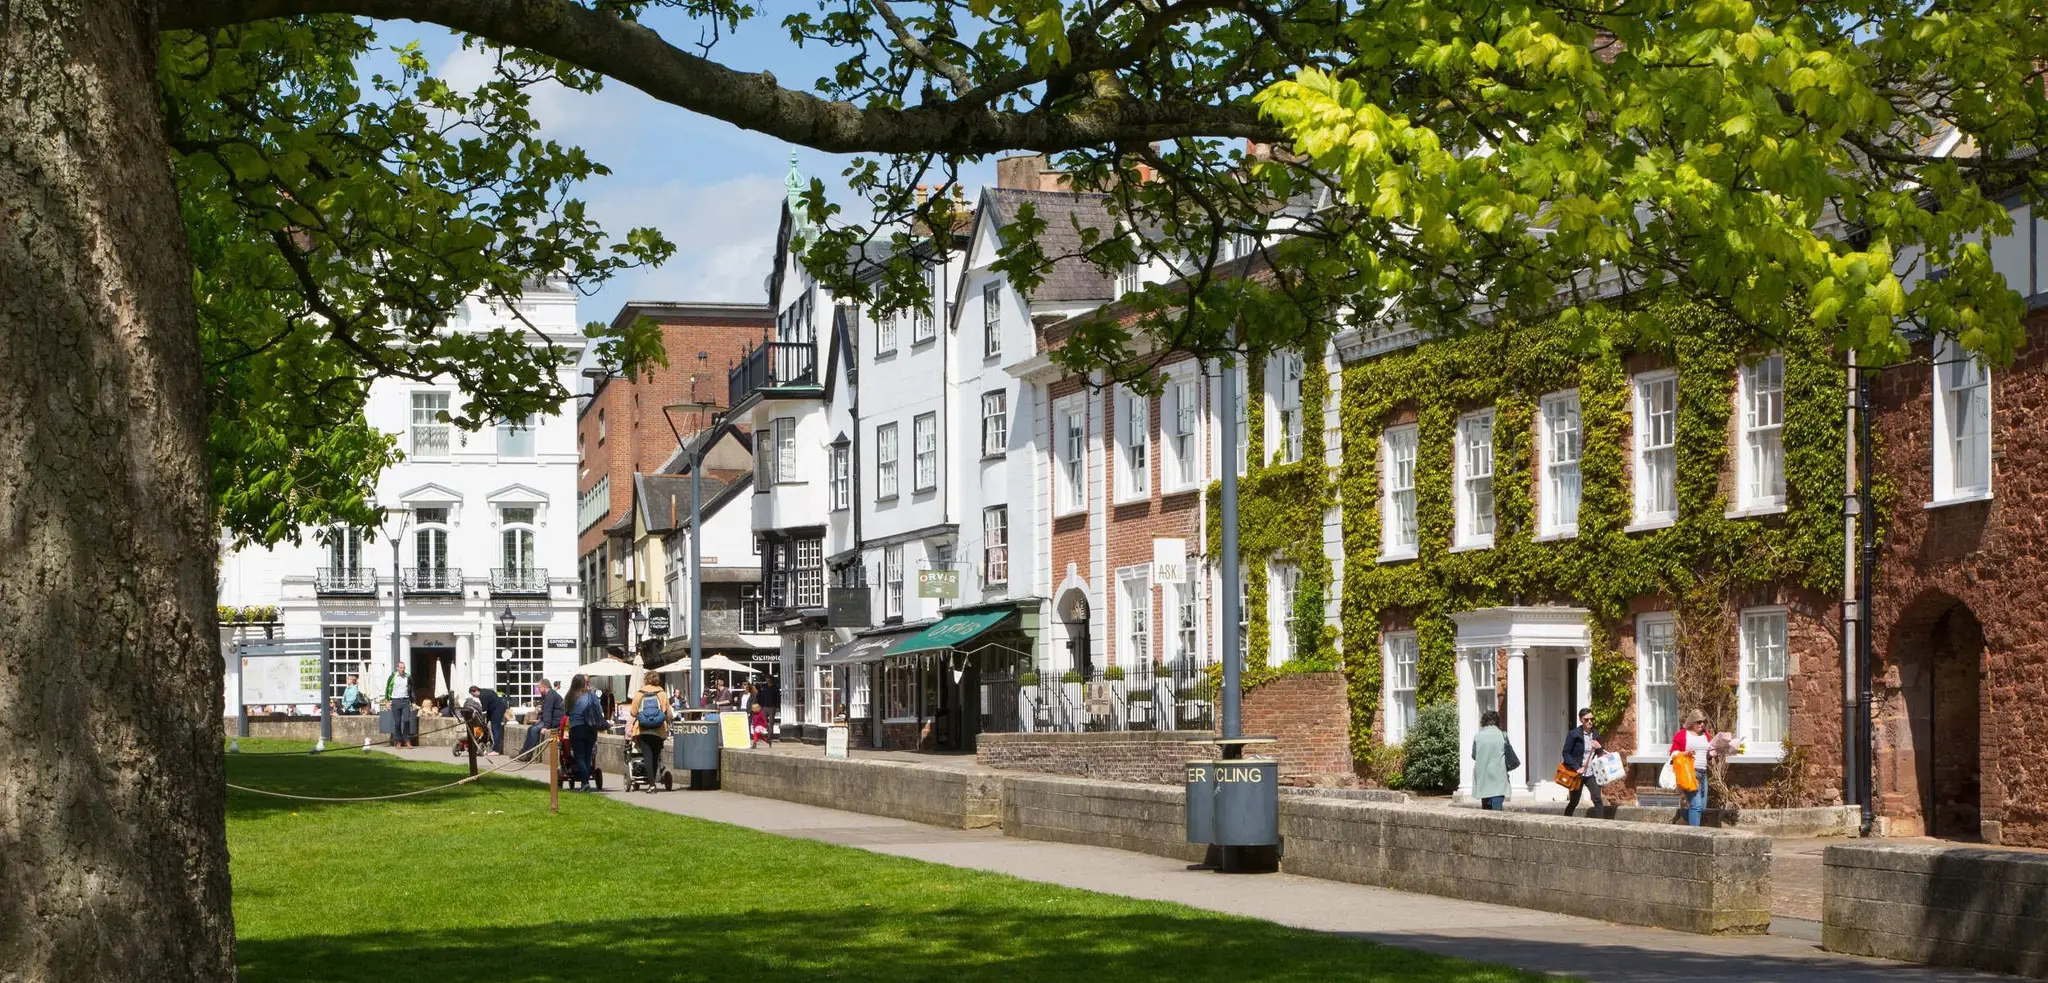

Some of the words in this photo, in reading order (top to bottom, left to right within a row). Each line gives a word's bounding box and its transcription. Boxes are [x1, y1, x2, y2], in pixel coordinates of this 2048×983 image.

[919, 572, 957, 583] ORVIS
[1158, 564, 1177, 580] ASK
[928, 620, 980, 637] ORVIS
